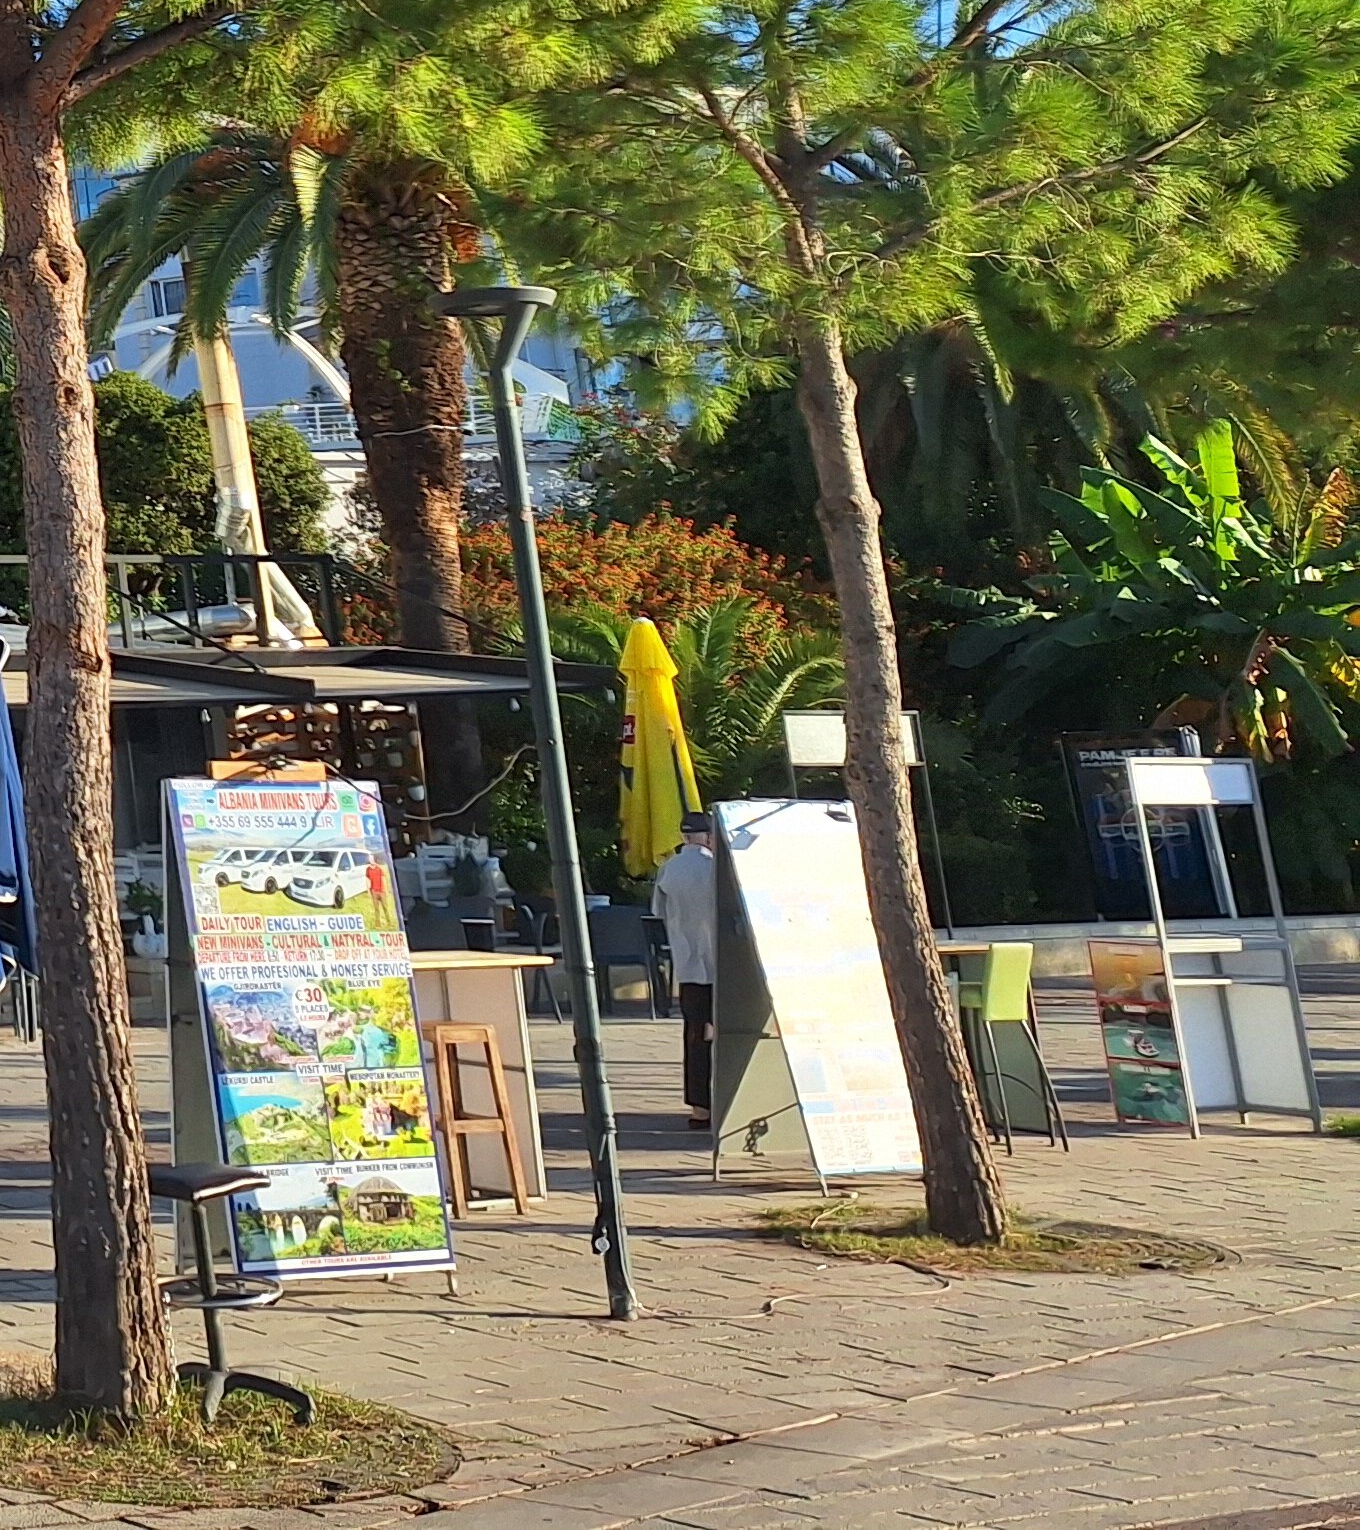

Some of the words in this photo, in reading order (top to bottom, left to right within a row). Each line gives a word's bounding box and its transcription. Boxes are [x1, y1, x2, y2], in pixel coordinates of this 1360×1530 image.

[218, 792, 258, 810] ALBANIA
[260, 792, 305, 810] MINIVANS
[307, 792, 338, 810] TOURS
[208, 816, 235, 828] +355
[238, 816, 251, 828] 69
[254, 816, 274, 828] 555
[277, 816, 298, 828] 444
[300, 816, 307, 828] 9
[201, 916, 230, 931] DAILY
[234, 916, 263, 931] TOUR
[267, 917, 317, 931] ENGLISH
[327, 916, 364, 930] GUIDE
[197, 936, 218, 950] NEW
[219, 935, 265, 950] MINIVANS
[272, 934, 322, 949] CULTURAL
[331, 934, 374, 948] NATYRAL
[380, 933, 405, 948] TOUR
[201, 967, 217, 981] WE
[219, 966, 250, 980] OFFER
[251, 964, 319, 980] PROFESIONAL
[331, 963, 370, 977] HONEST
[372, 962, 411, 976] SERVICE
[298, 1064, 321, 1075] VISIT
[322, 1063, 344, 1074] TIME
[315, 1166, 334, 1176] VISIT
[336, 1166, 354, 1175] TIME
